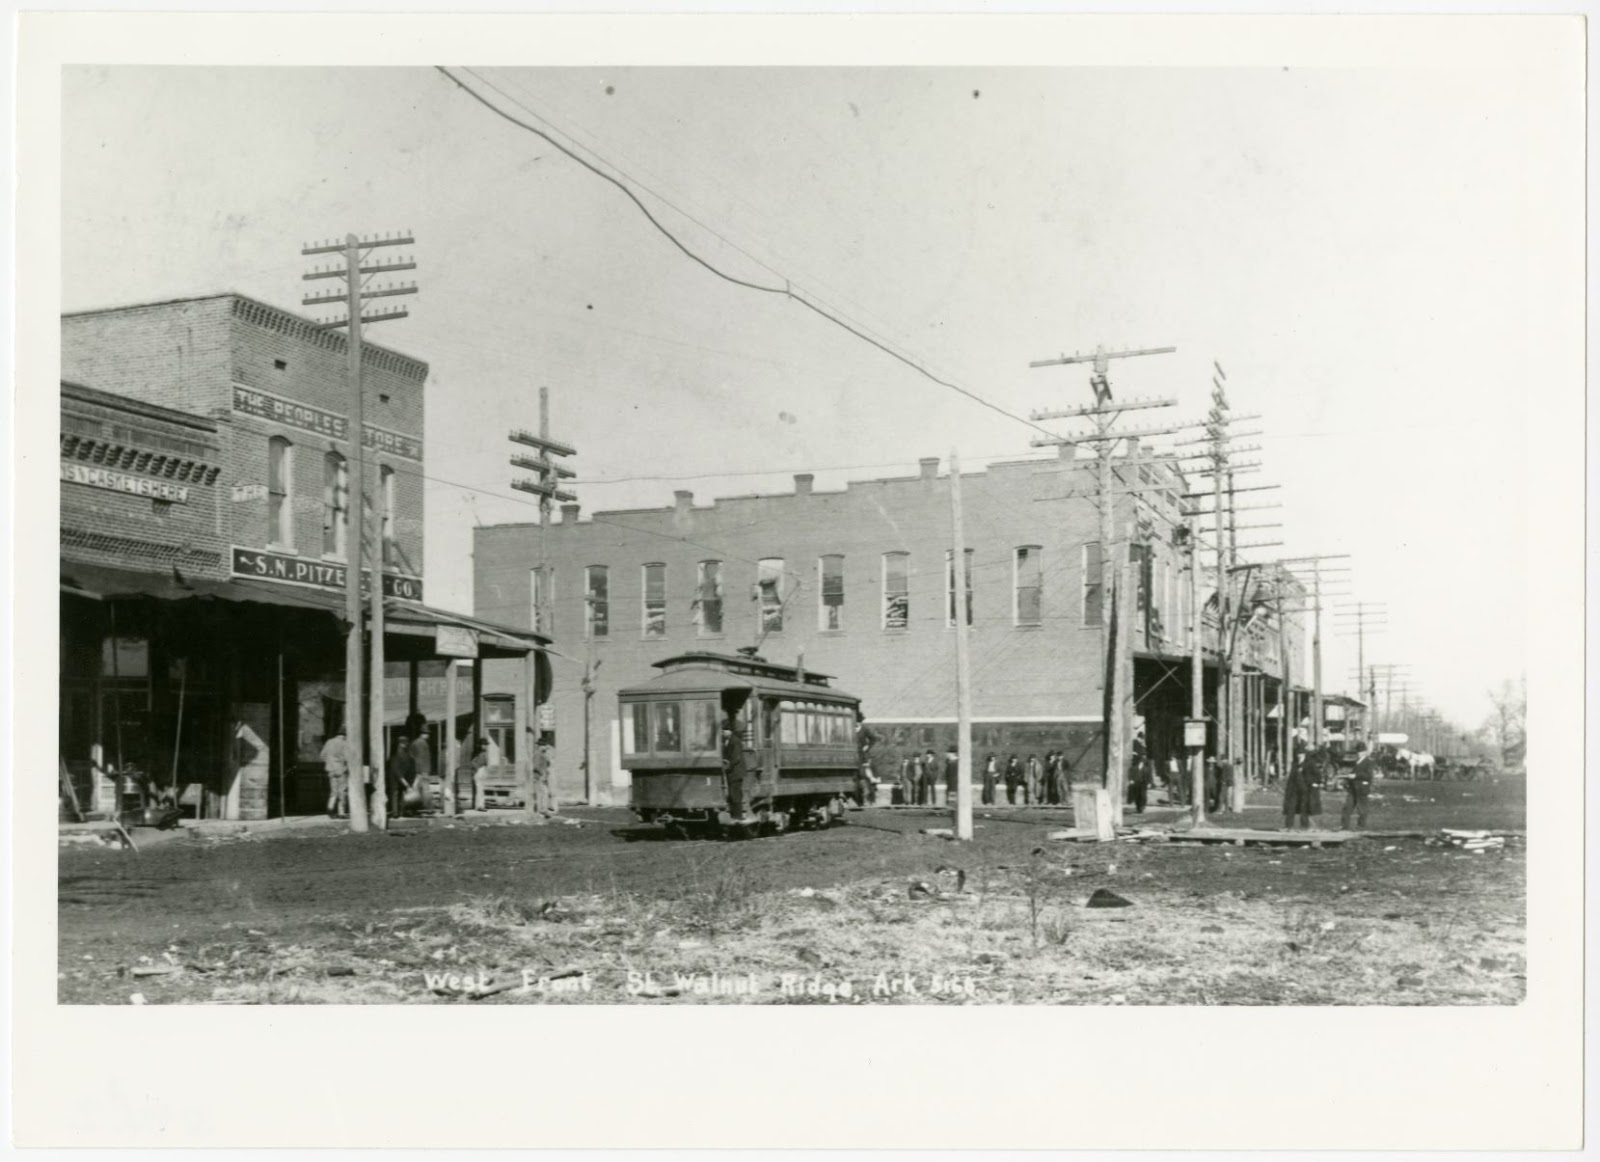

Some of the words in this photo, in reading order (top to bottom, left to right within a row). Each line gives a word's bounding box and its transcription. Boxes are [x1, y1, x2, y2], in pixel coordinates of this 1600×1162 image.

[236, 389, 265, 415] THE
[363, 427, 404, 455] TORE
[296, 562, 353, 586] PITZE
[387, 679, 436, 696] LUCH
